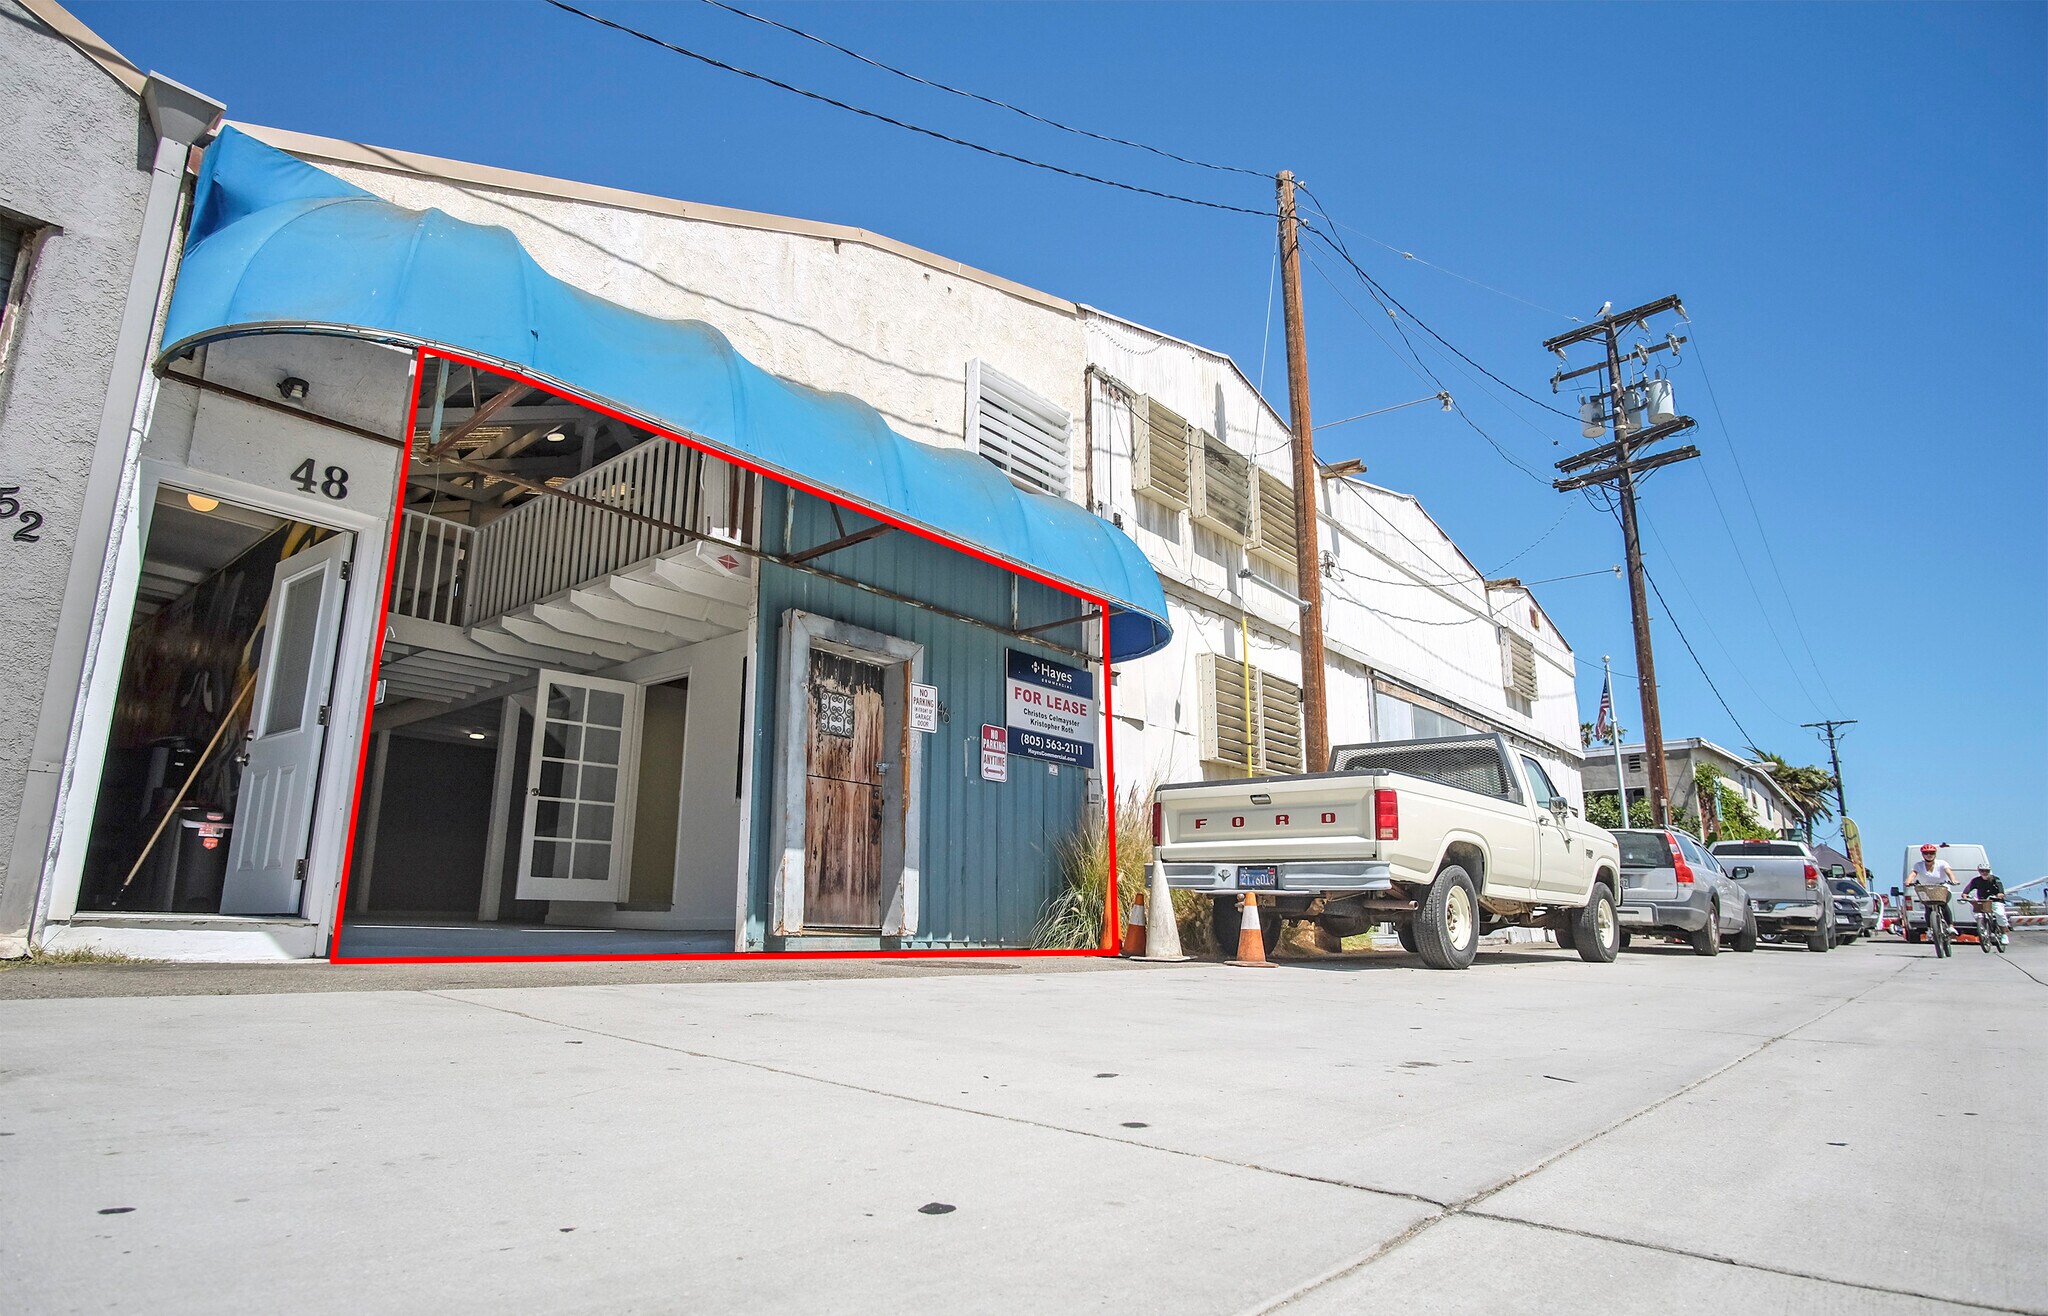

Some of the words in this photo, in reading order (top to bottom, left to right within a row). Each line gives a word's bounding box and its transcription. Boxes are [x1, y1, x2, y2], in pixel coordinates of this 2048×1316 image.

[290, 458, 349, 501] 48
[0, 486, 43, 543] 52
[1041, 663, 1073, 683] Hayes
[1041, 678, 1073, 690] COMMERCIAL
[919, 688, 929, 698] NO
[913, 696, 934, 708] PARKING
[1014, 686, 1042, 705] FOR
[1046, 694, 1087, 716] LEASE
[914, 713, 932, 721] GARAGE
[1023, 708, 1048, 720] Christos
[917, 719, 929, 728] DOOR
[1030, 718, 1061, 731] Kristopher
[1061, 725, 1075, 734] Roth
[990, 729, 999, 740] NO
[983, 738, 1006, 752] PARKING
[1020, 733, 1045, 750] (805)
[1045, 738, 1083, 756] 563-2111
[983, 753, 1005, 767] ANYTIME
[1195, 812, 1336, 829] FORD
